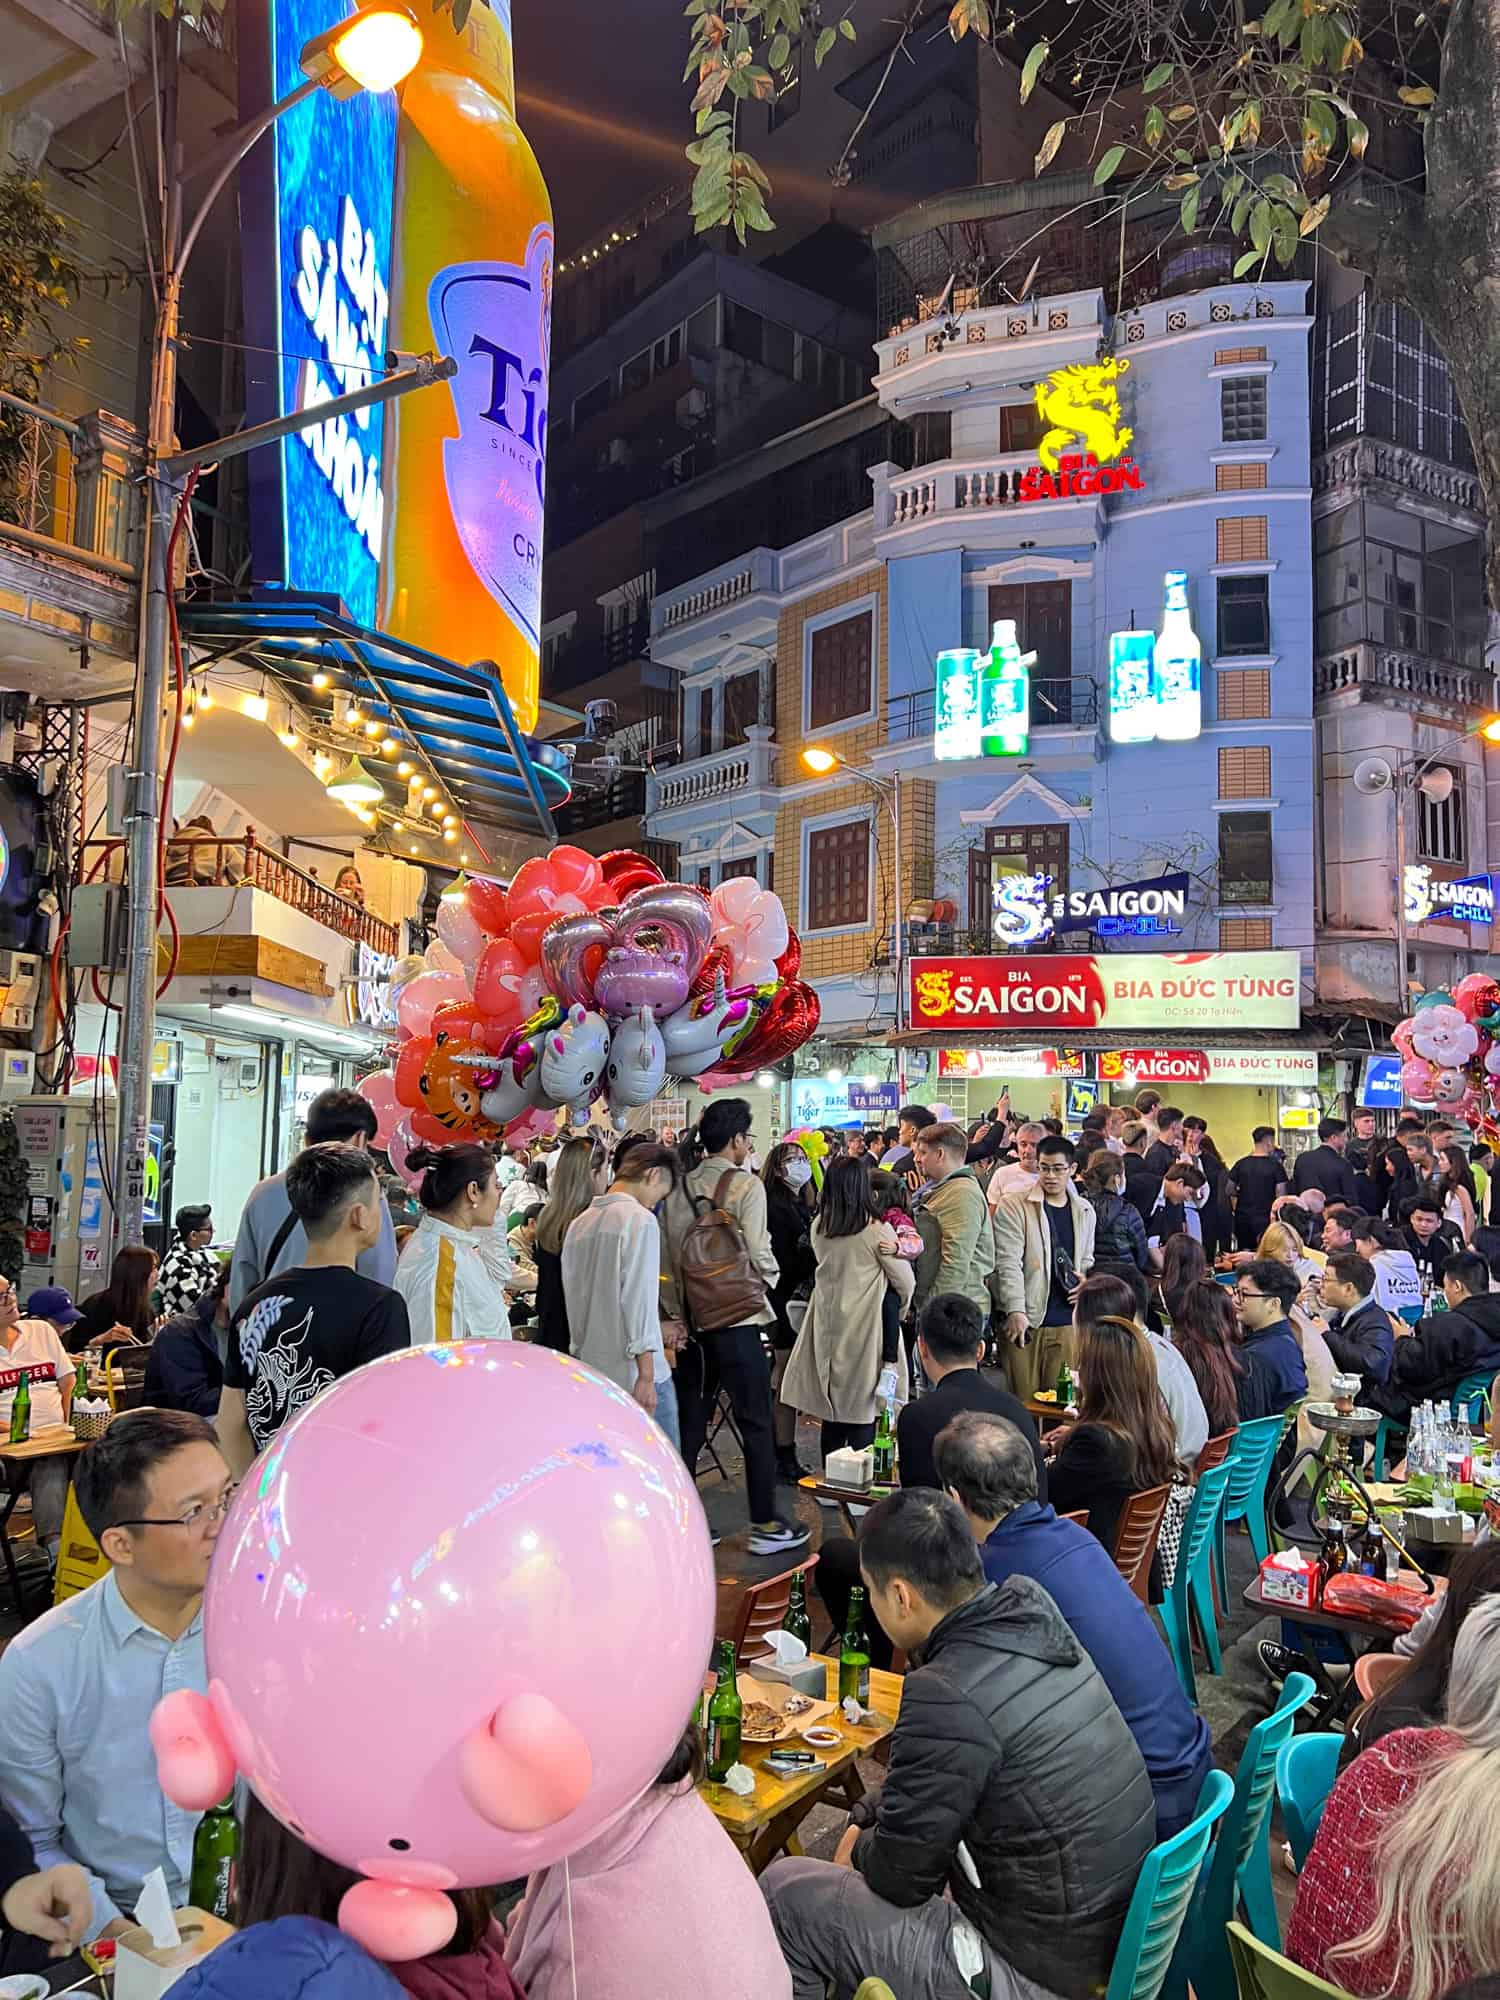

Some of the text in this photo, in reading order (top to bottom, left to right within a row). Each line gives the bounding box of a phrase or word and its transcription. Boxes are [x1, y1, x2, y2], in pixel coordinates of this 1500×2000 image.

[491, 438, 532, 473] SINCE
[1019, 465, 1141, 503] SAIGON
[1053, 890, 1185, 917] BIA SAIGON
[1439, 882, 1493, 908] SAIGON
[1452, 905, 1493, 922] CHILL
[1097, 916, 1183, 936] CHILL
[1008, 971, 1032, 983] BIA
[1113, 974, 1295, 999] BIA ĐỨC TÙNG
[954, 986, 1086, 1014] SAIGON
[1124, 1059, 1200, 1076] SAIGON
[1213, 1058, 1237, 1069] BIA
[1274, 1055, 1314, 1070] TÙNG
[797, 1105, 820, 1121] Tiger
